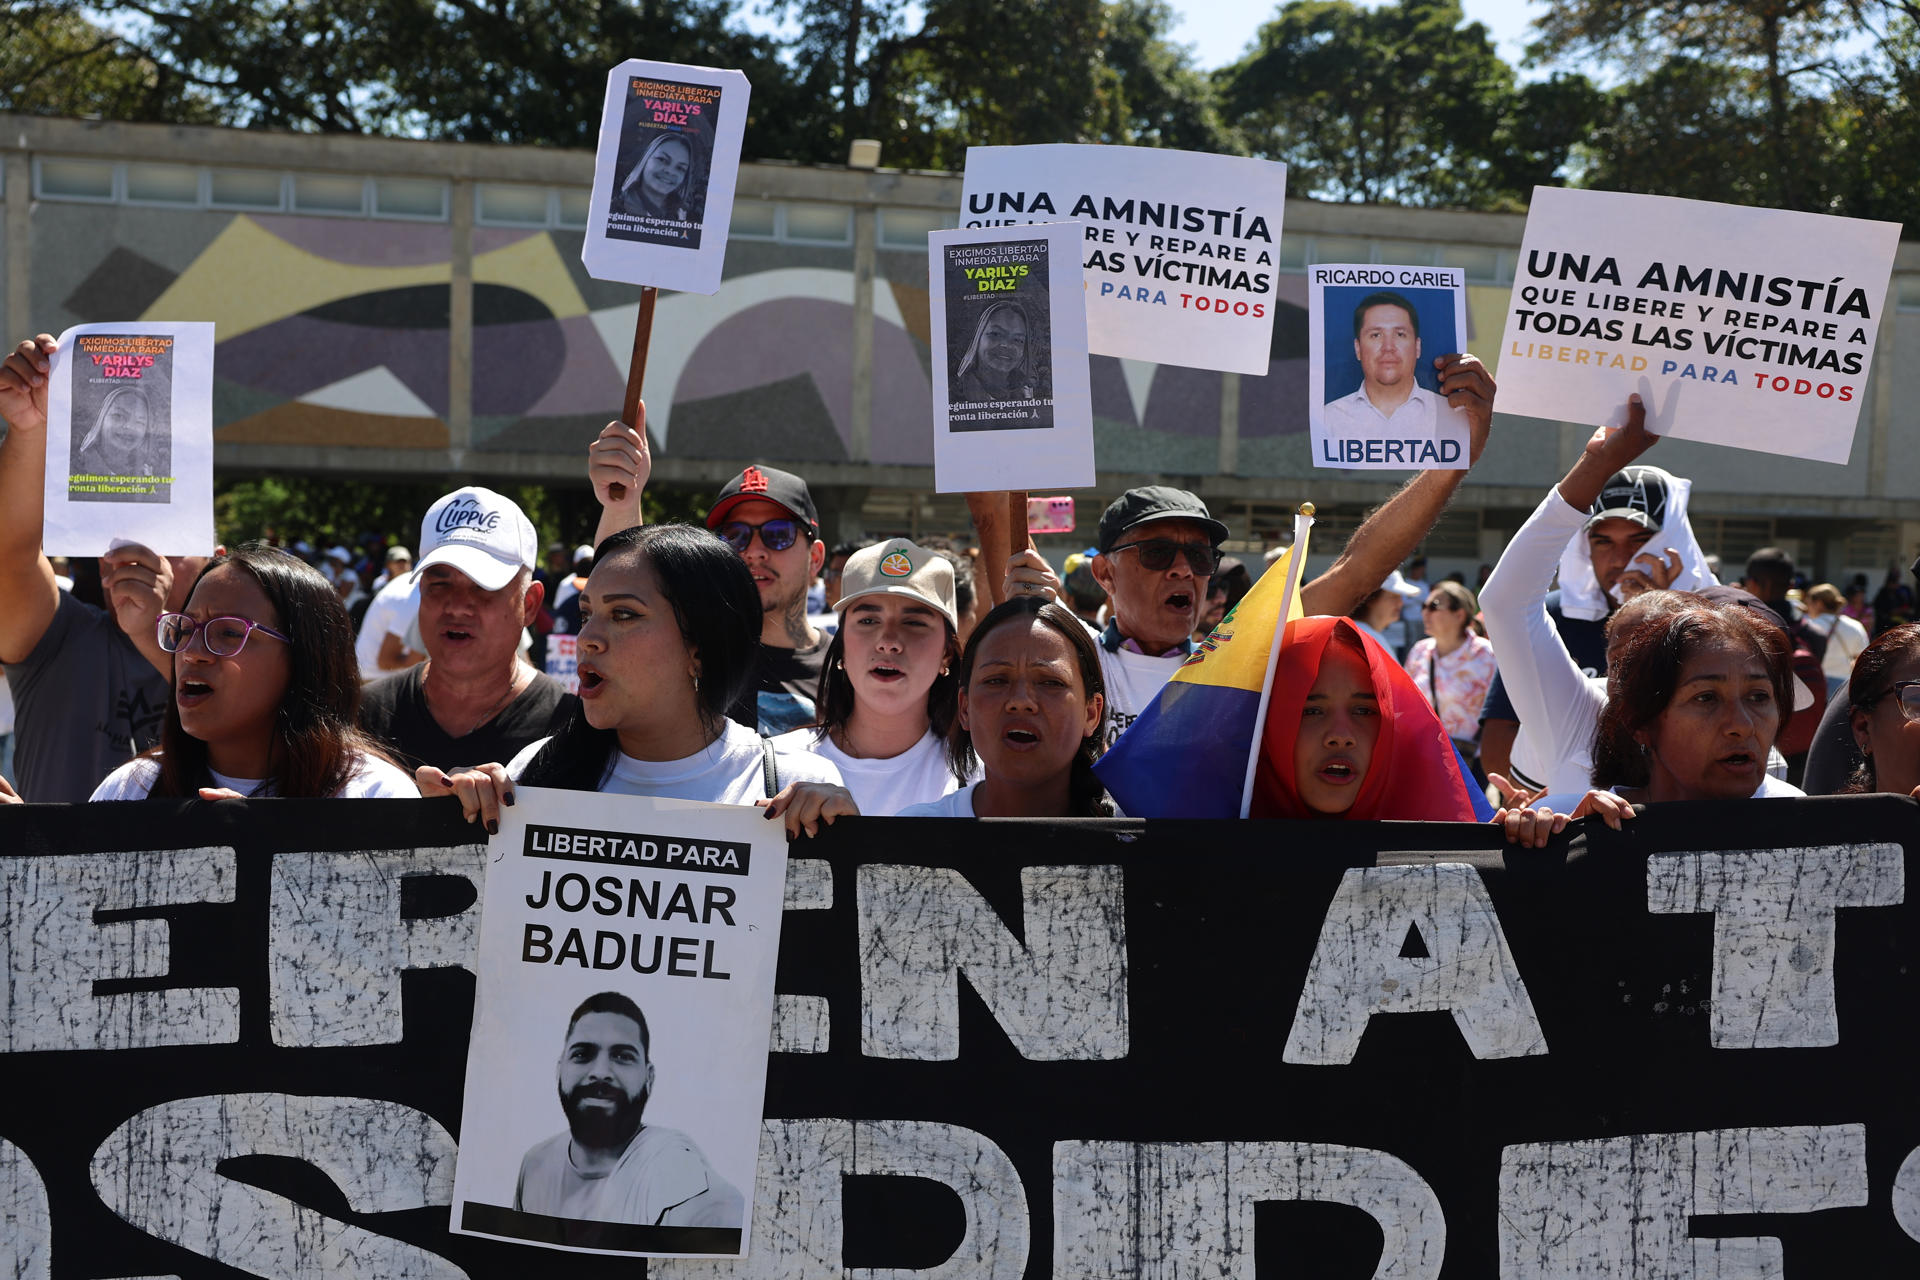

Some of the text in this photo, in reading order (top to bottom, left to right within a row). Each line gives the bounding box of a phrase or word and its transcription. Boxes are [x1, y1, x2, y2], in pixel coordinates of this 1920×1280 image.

[632, 80, 721, 98] EXIGIMOS LIBERTAD
[636, 88, 713, 105] INMEDIATA PARA
[644, 99, 701, 116] YARILYS
[653, 109, 688, 126] DÍAZ
[645, 216, 692, 230] esperando
[969, 192, 1057, 215] UNA
[1070, 195, 1273, 244] AMNISTÍA
[633, 224, 679, 238] liberación
[950, 244, 1048, 259] EXIGIMOS LIBERTAD
[1126, 231, 1140, 246] Y
[1150, 235, 1246, 263] REPARE
[1256, 250, 1272, 267] A
[955, 254, 1040, 267] INMEDIATA PARA
[964, 265, 1029, 280] YARILYS
[1083, 250, 1271, 294] AS VÍCTIMAS
[1316, 270, 1460, 288] RICARDO CARIEL
[978, 276, 1016, 292] DÍAZ
[1526, 250, 1872, 320] UNA AMNISTÍA
[1100, 282, 1168, 306] PARA
[1180, 293, 1266, 319] TODOS
[1520, 286, 1868, 346] QUE LIBERE Y REPARE A
[79, 337, 173, 347] EXIGIMOS LIBERTAD
[83, 344, 165, 354] INMEDIATA PARA
[1515, 309, 1863, 376] TODAS LAS VÍCTIMAS
[92, 354, 155, 367] YARILYS
[104, 365, 143, 378] DÍAZ
[1511, 341, 1854, 402] LIBERTAD PARA TODOS
[989, 398, 1042, 410] esperando
[977, 410, 1029, 421] liberación
[1323, 439, 1461, 464] LIBERTAD
[110, 474, 160, 485] esperando
[98, 484, 147, 493] liberación
[531, 832, 740, 869] LIBERTAD PARA
[525, 870, 737, 927] JOSNAR
[521, 924, 731, 981] BADUEL
[1283, 862, 1550, 1066] A
